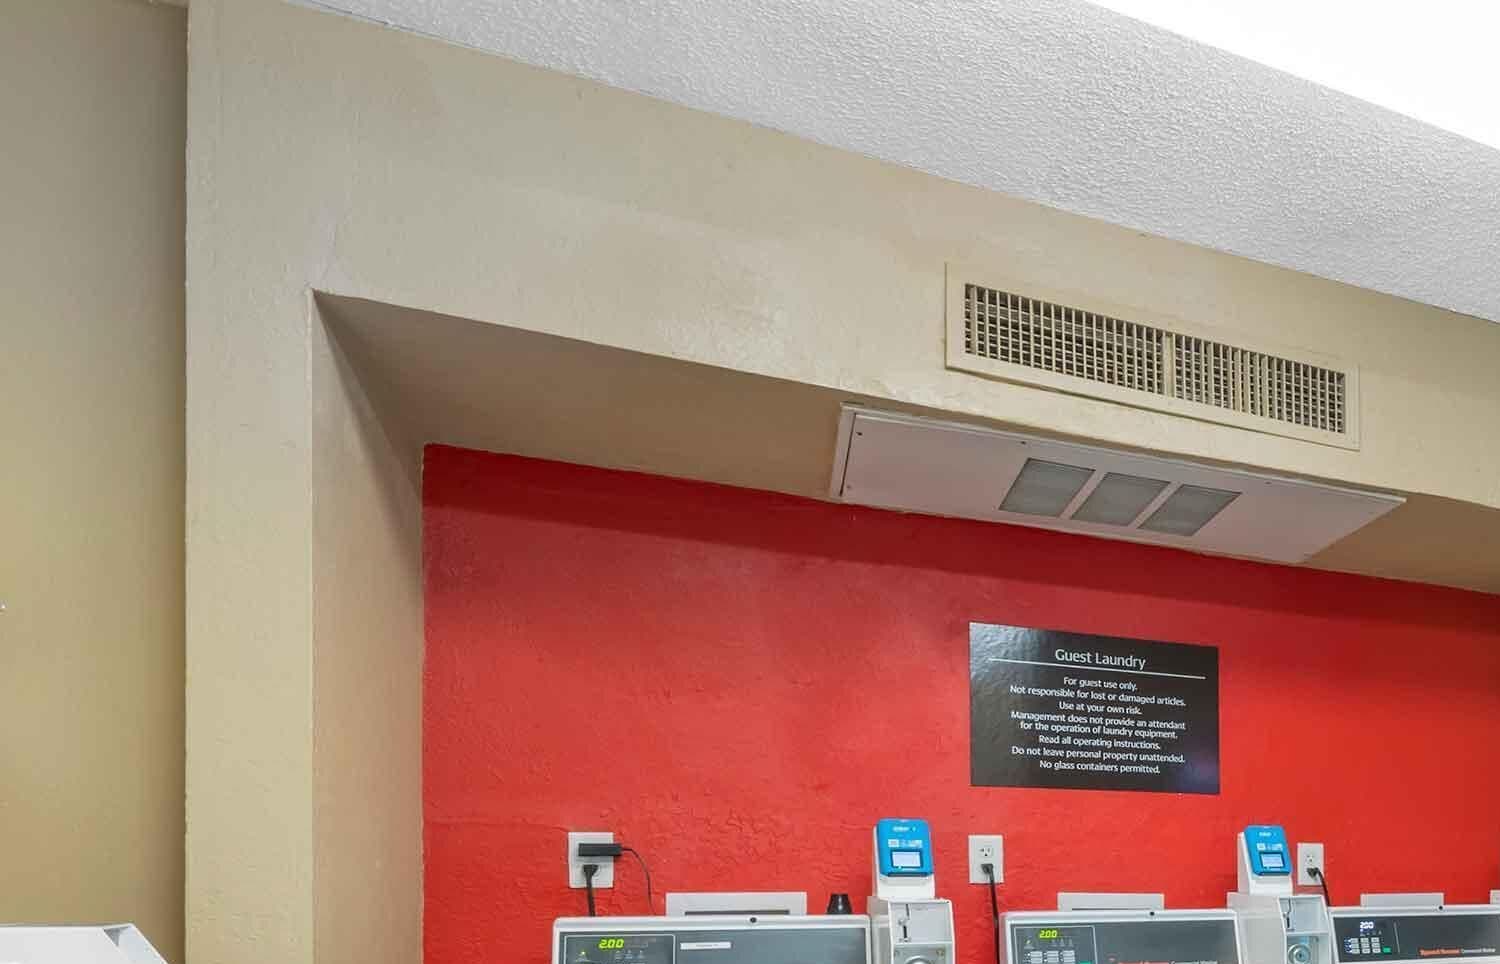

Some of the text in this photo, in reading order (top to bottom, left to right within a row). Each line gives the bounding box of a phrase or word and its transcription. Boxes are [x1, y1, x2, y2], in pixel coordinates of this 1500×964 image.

[1055, 648, 1146, 670] Guest Laundry
[1063, 677, 1077, 686] For
[1079, 679, 1101, 688] guest
[1103, 681, 1117, 689] use
[1009, 685, 1025, 694] Not
[1027, 687, 1075, 698] responsible
[1077, 690, 1089, 699] for
[1091, 691, 1105, 700] lost
[1119, 694, 1155, 705] damaged
[1059, 701, 1074, 710] Use
[1076, 703, 1085, 711] at
[1087, 704, 1105, 713] your
[1106, 706, 1125, 714] own
[1011, 710, 1066, 723] Management
[1068, 714, 1088, 723] does
[1089, 716, 1104, 725] not
[1105, 717, 1135, 727] provide
[1148, 720, 1186, 730] attendant
[1020, 720, 1033, 729] for
[1035, 721, 1049, 731] the
[1051, 723, 1091, 734] operation
[1092, 726, 1101, 734] of
[1103, 726, 1133, 738] laundry
[1039, 735, 1060, 744] Read
[1062, 736, 1071, 745] all
[1073, 738, 1112, 749] operating
[1011, 746, 1025, 755] Do
[1026, 747, 1041, 756] not
[1043, 747, 1065, 757] leave
[1066, 750, 1101, 761] personal
[1103, 751, 1138, 762] property
[1040, 760, 1052, 769] No
[1054, 761, 1075, 771] glass
[1076, 762, 1119, 773] containers
